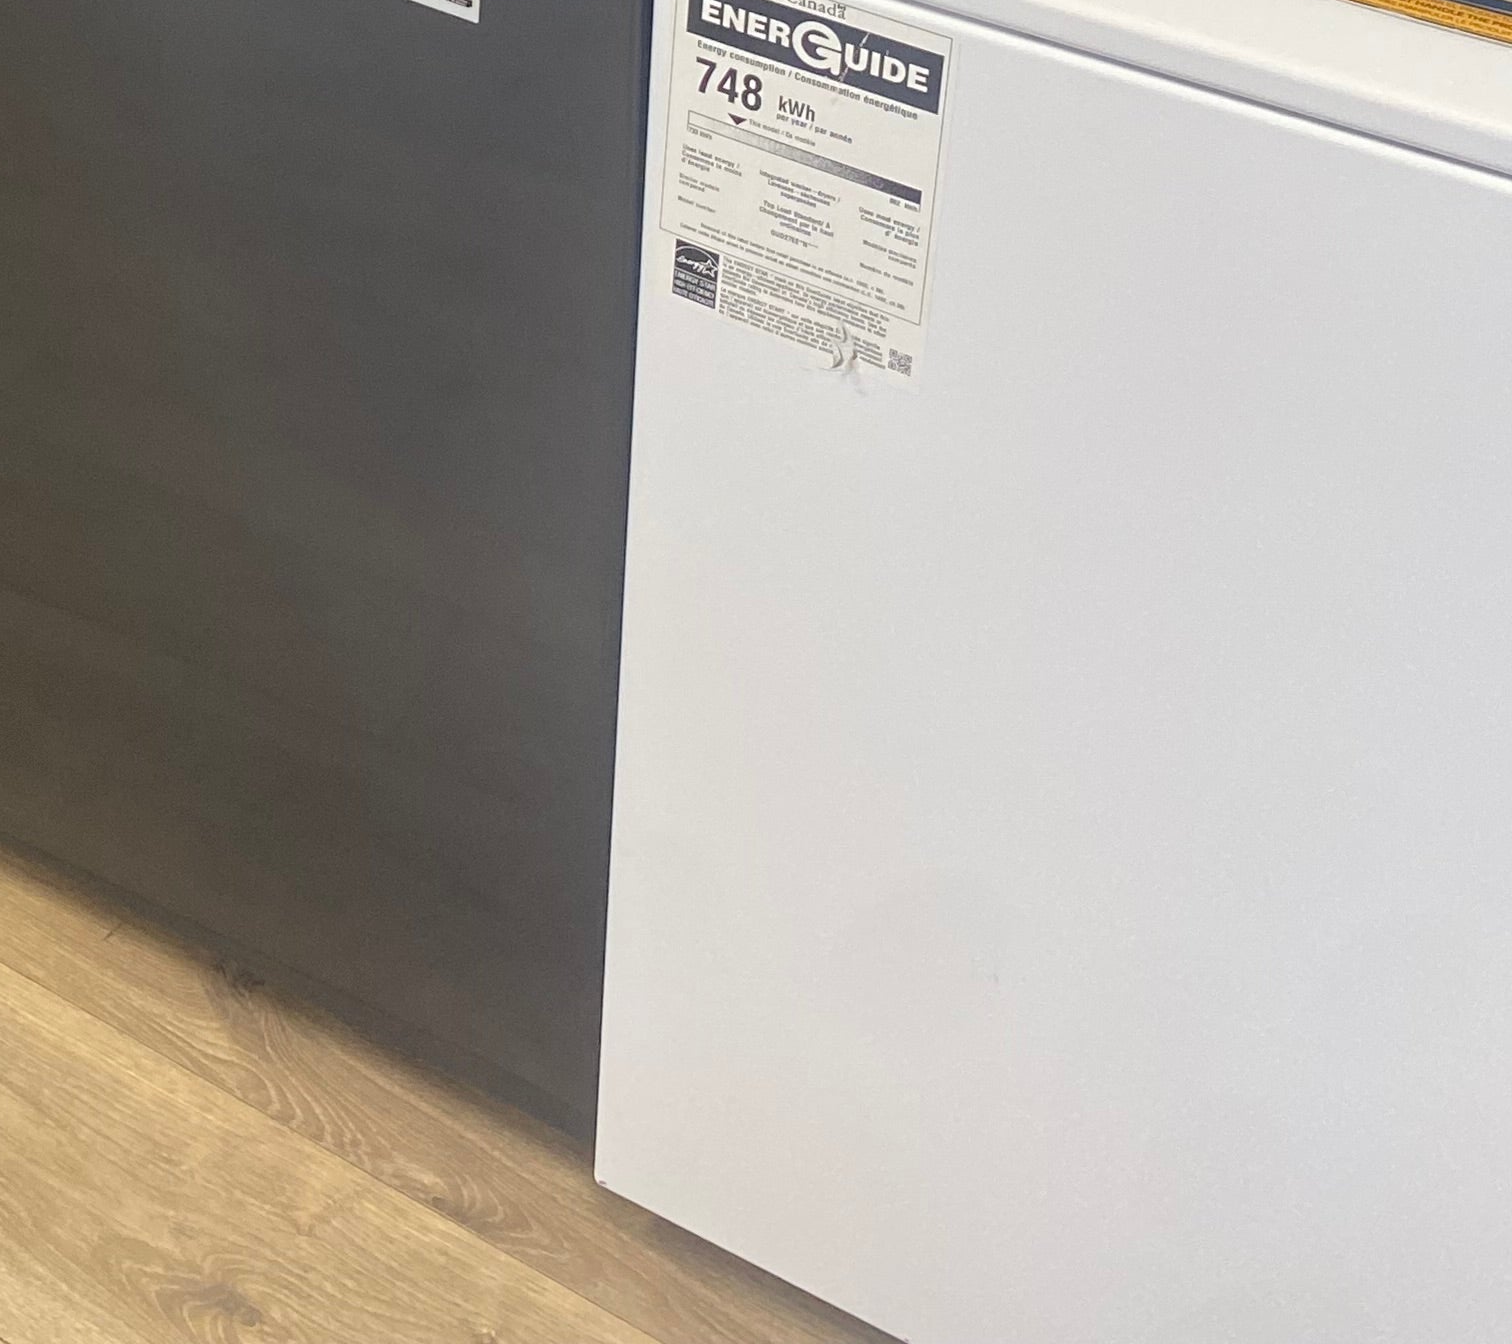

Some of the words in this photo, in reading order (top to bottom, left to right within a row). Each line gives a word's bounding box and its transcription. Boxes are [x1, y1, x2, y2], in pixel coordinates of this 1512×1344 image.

[695, 55, 764, 112] 748
[697, 39, 727, 58] Energy
[729, 51, 787, 77] consumption
[794, 71, 861, 101] Consommation
[863, 94, 918, 120] énergétique
[778, 95, 816, 123] kWh
